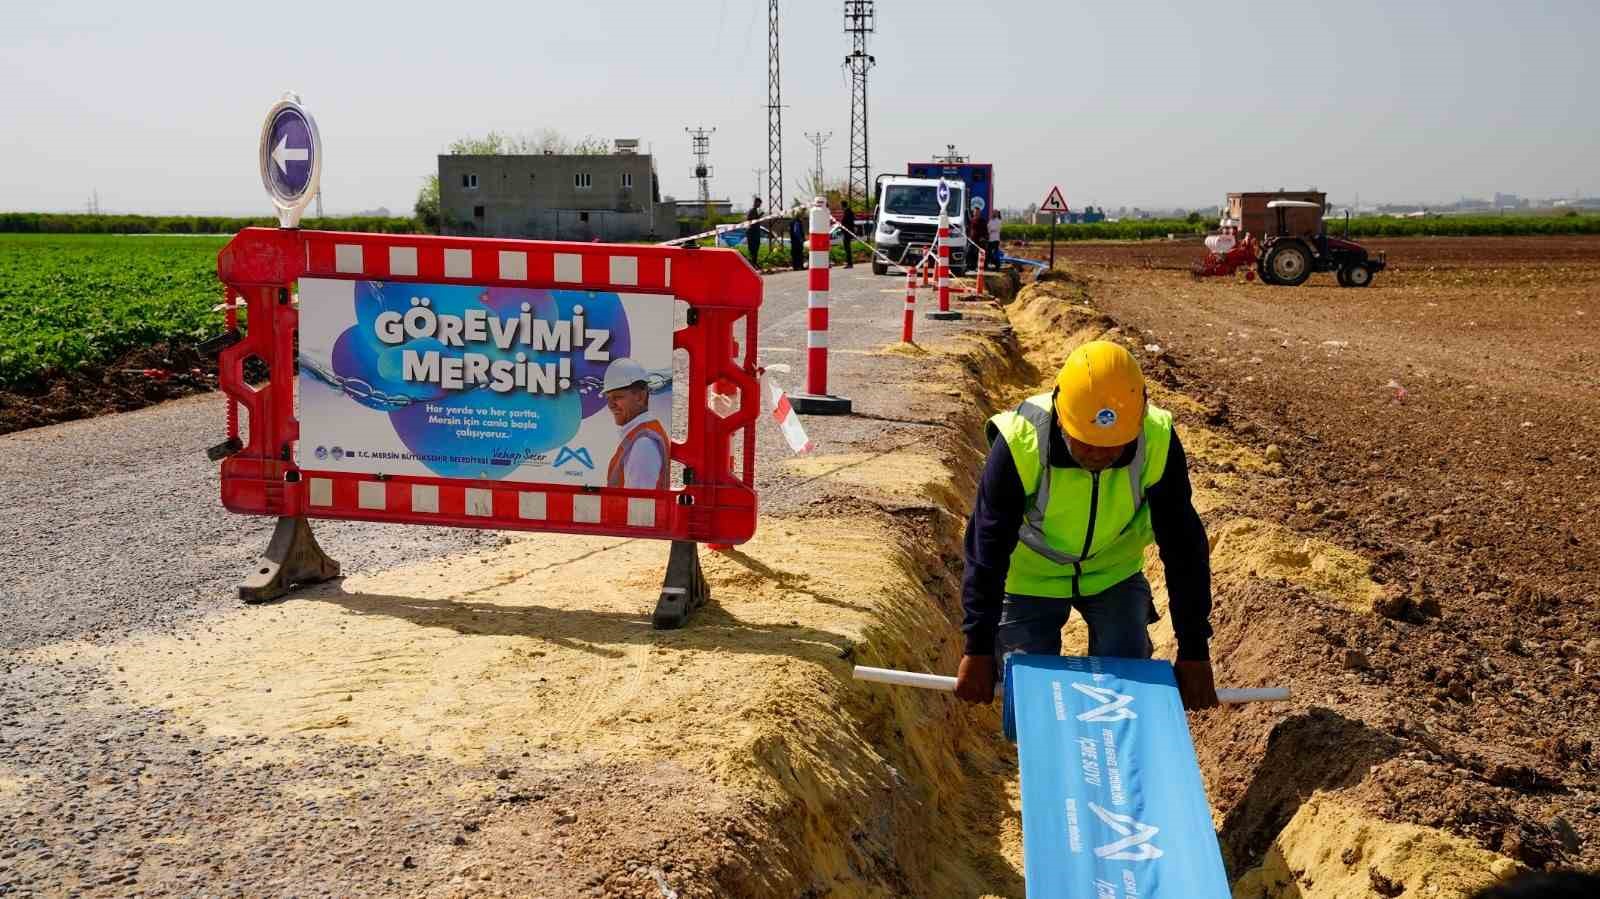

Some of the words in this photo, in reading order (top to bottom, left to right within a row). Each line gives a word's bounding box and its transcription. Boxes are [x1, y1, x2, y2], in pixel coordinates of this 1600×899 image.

[374, 297, 610, 361] GÖREVİMİZ
[402, 350, 571, 394] MERSİN!
[426, 403, 443, 413] Her
[446, 405, 474, 416] yerde
[477, 408, 488, 416] ve
[490, 407, 506, 416] her
[428, 416, 461, 425] Mersin
[463, 417, 480, 427] için
[482, 418, 508, 428] canla
[511, 420, 538, 431] başla
[372, 452, 400, 460] MERSİN
